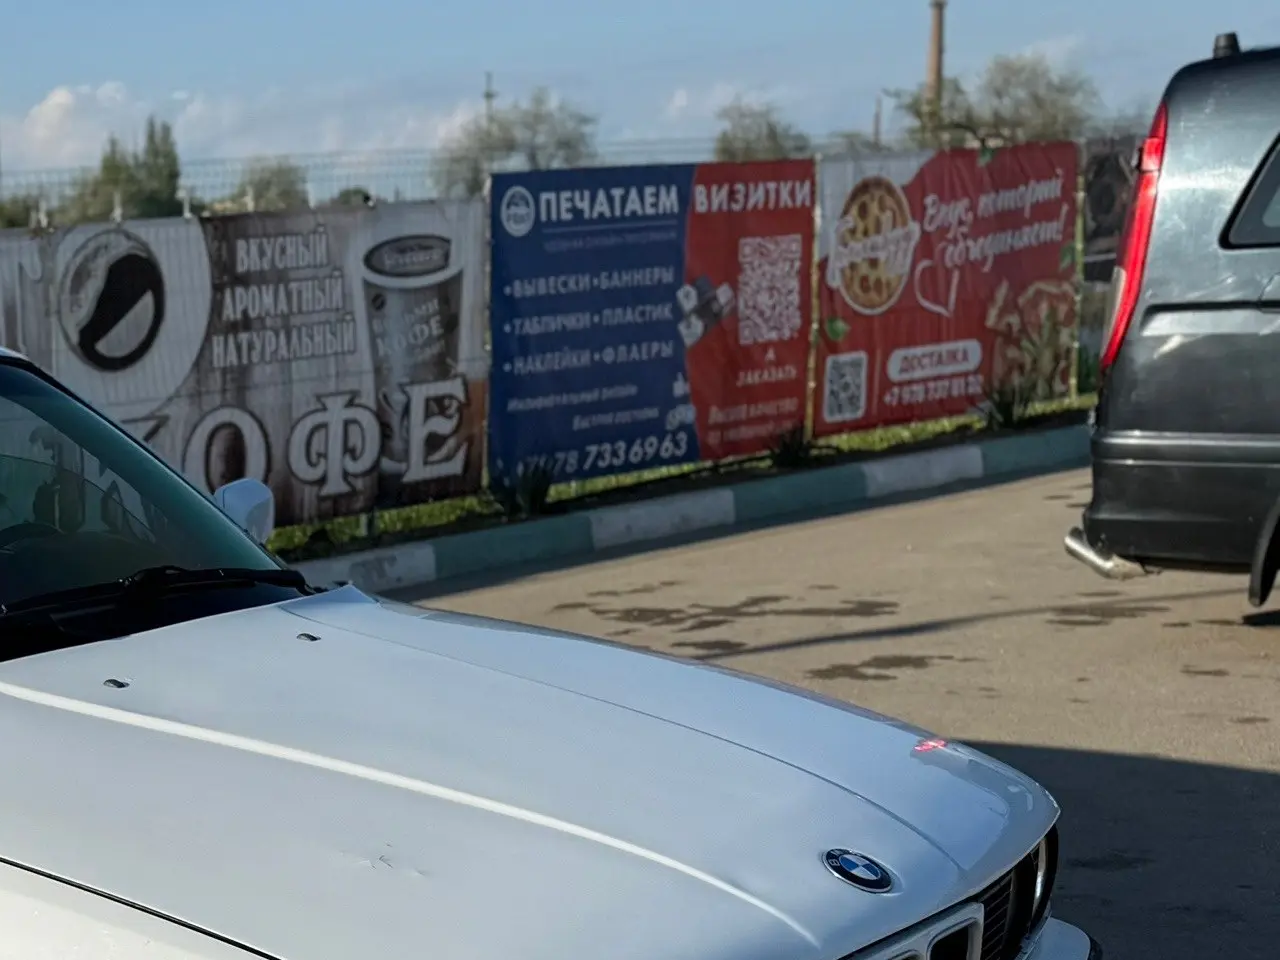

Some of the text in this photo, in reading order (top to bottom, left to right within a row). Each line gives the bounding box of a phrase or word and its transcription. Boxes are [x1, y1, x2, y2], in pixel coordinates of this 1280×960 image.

[539, 184, 679, 222] ПЕЧАТАЕМ
[694, 179, 812, 213] ВИЗИТКИ
[236, 224, 328, 274] ВКУСНЫЙ
[222, 270, 344, 322] АРОМАТНЫЙ
[513, 266, 675, 299] ВЫВЕСКИ БАННЕРЫ
[602, 303, 674, 327] ПЛАСТИК
[211, 315, 357, 368] НАТУРАЛЬНЫЙ
[513, 349, 592, 376] НАКЛЕЙКИ
